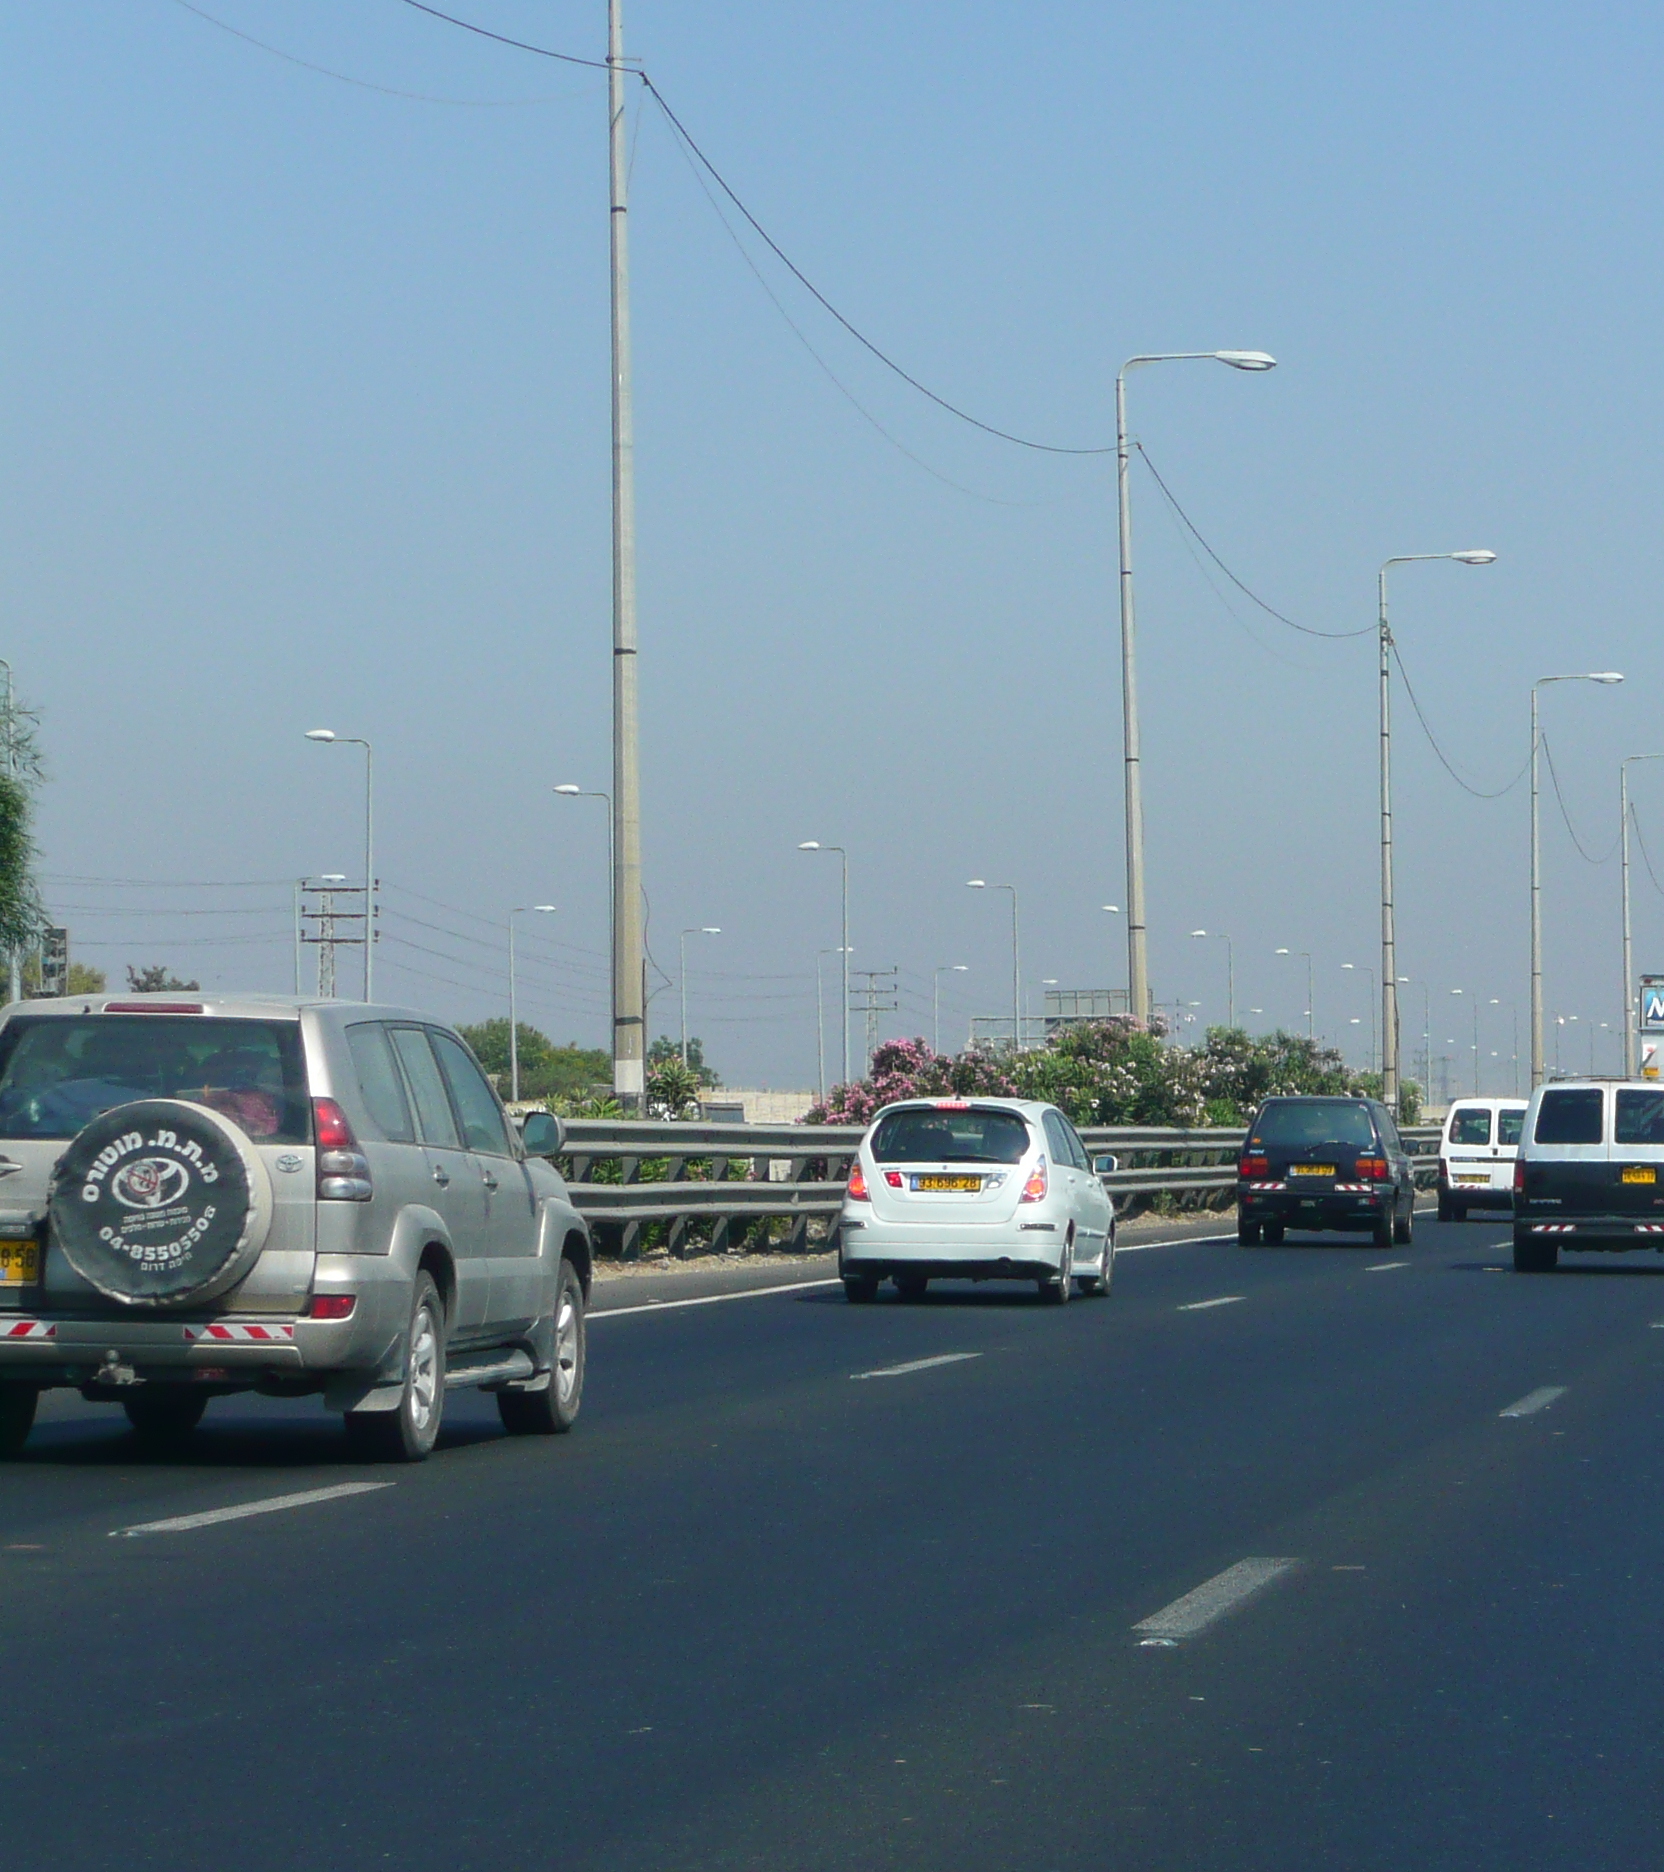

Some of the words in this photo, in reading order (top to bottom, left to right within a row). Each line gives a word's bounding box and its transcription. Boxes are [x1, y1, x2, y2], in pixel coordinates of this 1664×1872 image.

[82, 1131, 143, 1203] מוטורס
[99, 1216, 211, 1261] 04-8550550
[140, 1261, 165, 1271] דרום
